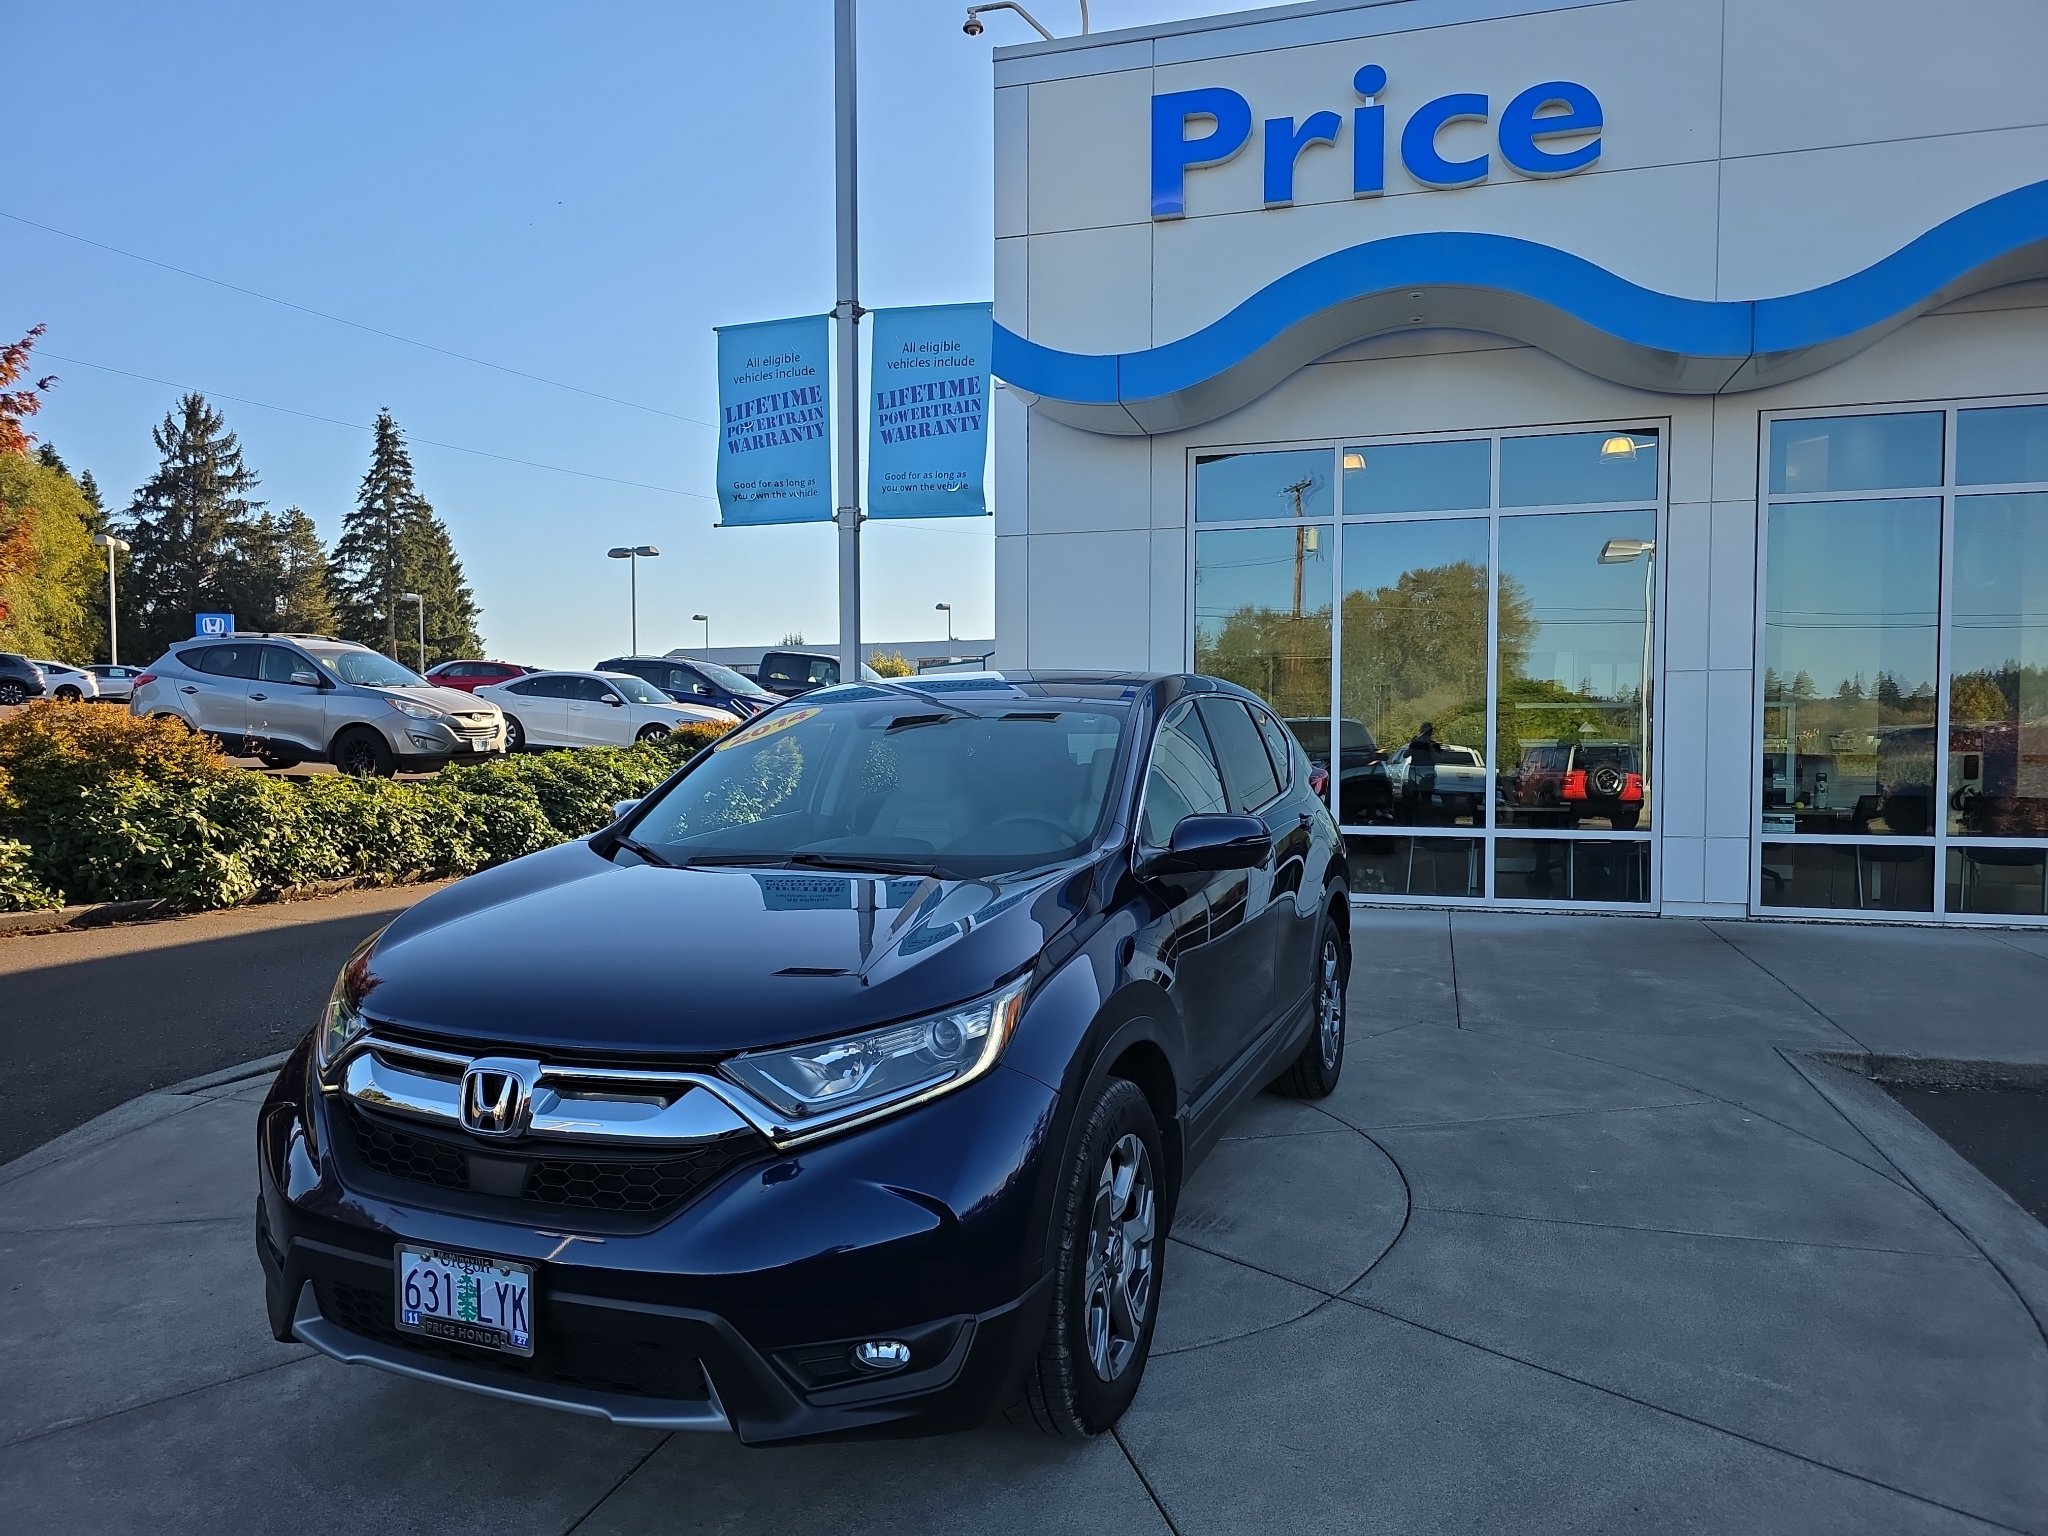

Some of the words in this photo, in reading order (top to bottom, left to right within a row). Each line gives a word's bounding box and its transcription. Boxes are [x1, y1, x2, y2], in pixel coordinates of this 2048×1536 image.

[1151, 64, 1604, 221] Price
[902, 342, 916, 353] All
[919, 340, 960, 355] eligible
[746, 357, 760, 369] All
[763, 352, 800, 367] eligible
[887, 356, 930, 369] vehicles
[934, 355, 975, 367] include
[733, 369, 773, 384] vehicles
[776, 365, 815, 379] include
[876, 376, 981, 411] LIFETIME
[725, 385, 822, 424] LIFETIME
[879, 398, 981, 428] POWERTRAIN
[727, 406, 824, 439] POWERTRAIN
[880, 415, 982, 445] WARRANTY
[728, 422, 825, 455] WARRANTY
[733, 480, 757, 490] Good
[759, 479, 772, 488] for
[774, 480, 784, 488] as
[786, 478, 805, 490] long
[807, 478, 815, 486] as
[884, 471, 907, 482] Good
[908, 471, 920, 480] for
[923, 472, 933, 480] as
[935, 470, 954, 481] long
[956, 471, 966, 479] as
[732, 492, 748, 502] you
[772, 490, 787, 499] the
[882, 484, 897, 494] you
[900, 484, 918, 492] own
[920, 483, 934, 491] the
[728, 711, 809, 746] 2014
[438, 1251, 490, 1267] McMinnville
[405, 1268, 451, 1316] 631
[476, 1278, 527, 1331] LYK
[408, 1312, 418, 1324] 11
[427, 1321, 455, 1336] PRICE
[458, 1328, 500, 1345] HONDA
[517, 1336, 527, 1345] 27
